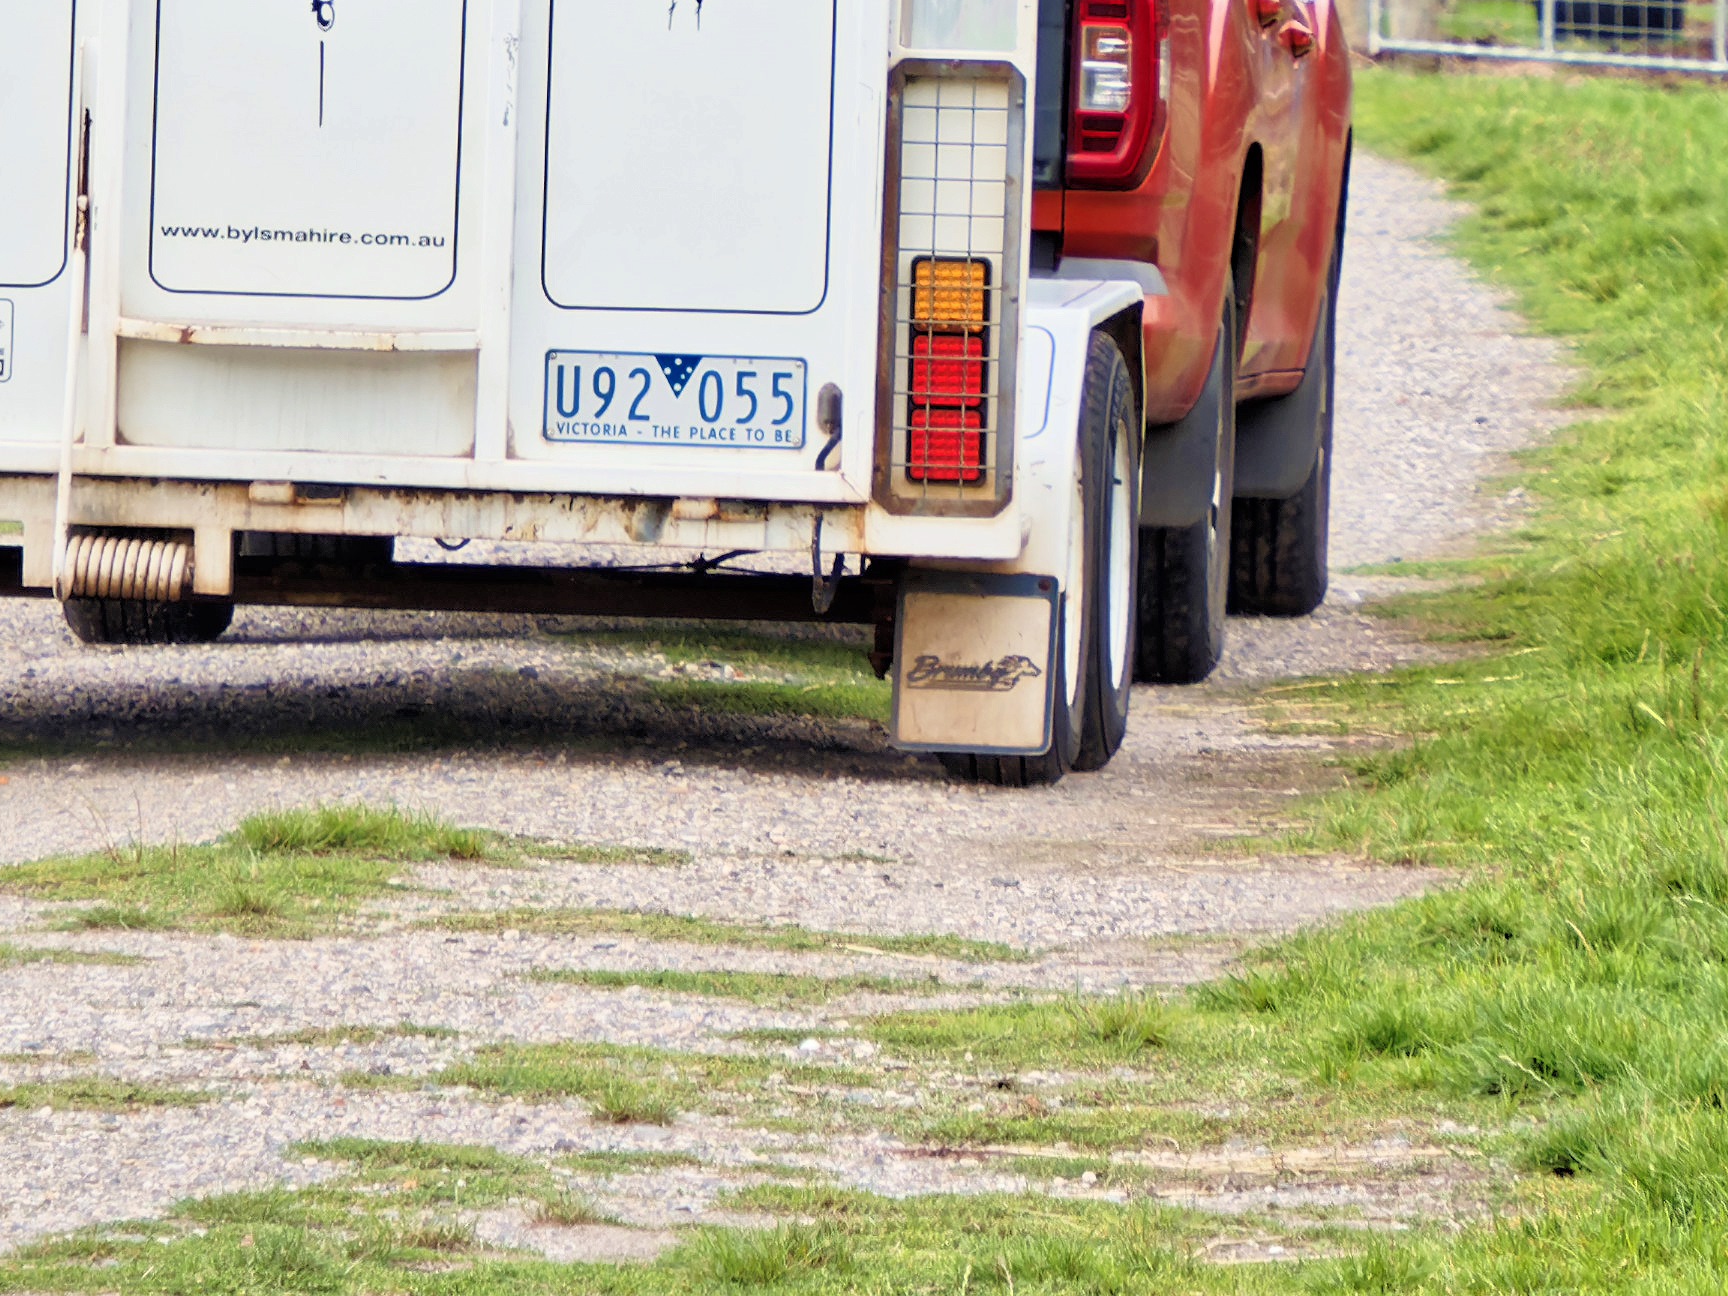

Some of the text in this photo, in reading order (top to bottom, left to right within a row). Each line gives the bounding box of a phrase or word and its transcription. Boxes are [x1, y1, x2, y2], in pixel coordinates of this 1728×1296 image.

[161, 225, 445, 248] www.bylsmahire.com.au
[557, 365, 794, 425] U92 055
[556, 422, 627, 437] VICTORIA
[653, 426, 680, 439] THE
[690, 427, 736, 441] PLACE
[747, 429, 765, 442] TO
[775, 430, 791, 442] BE
